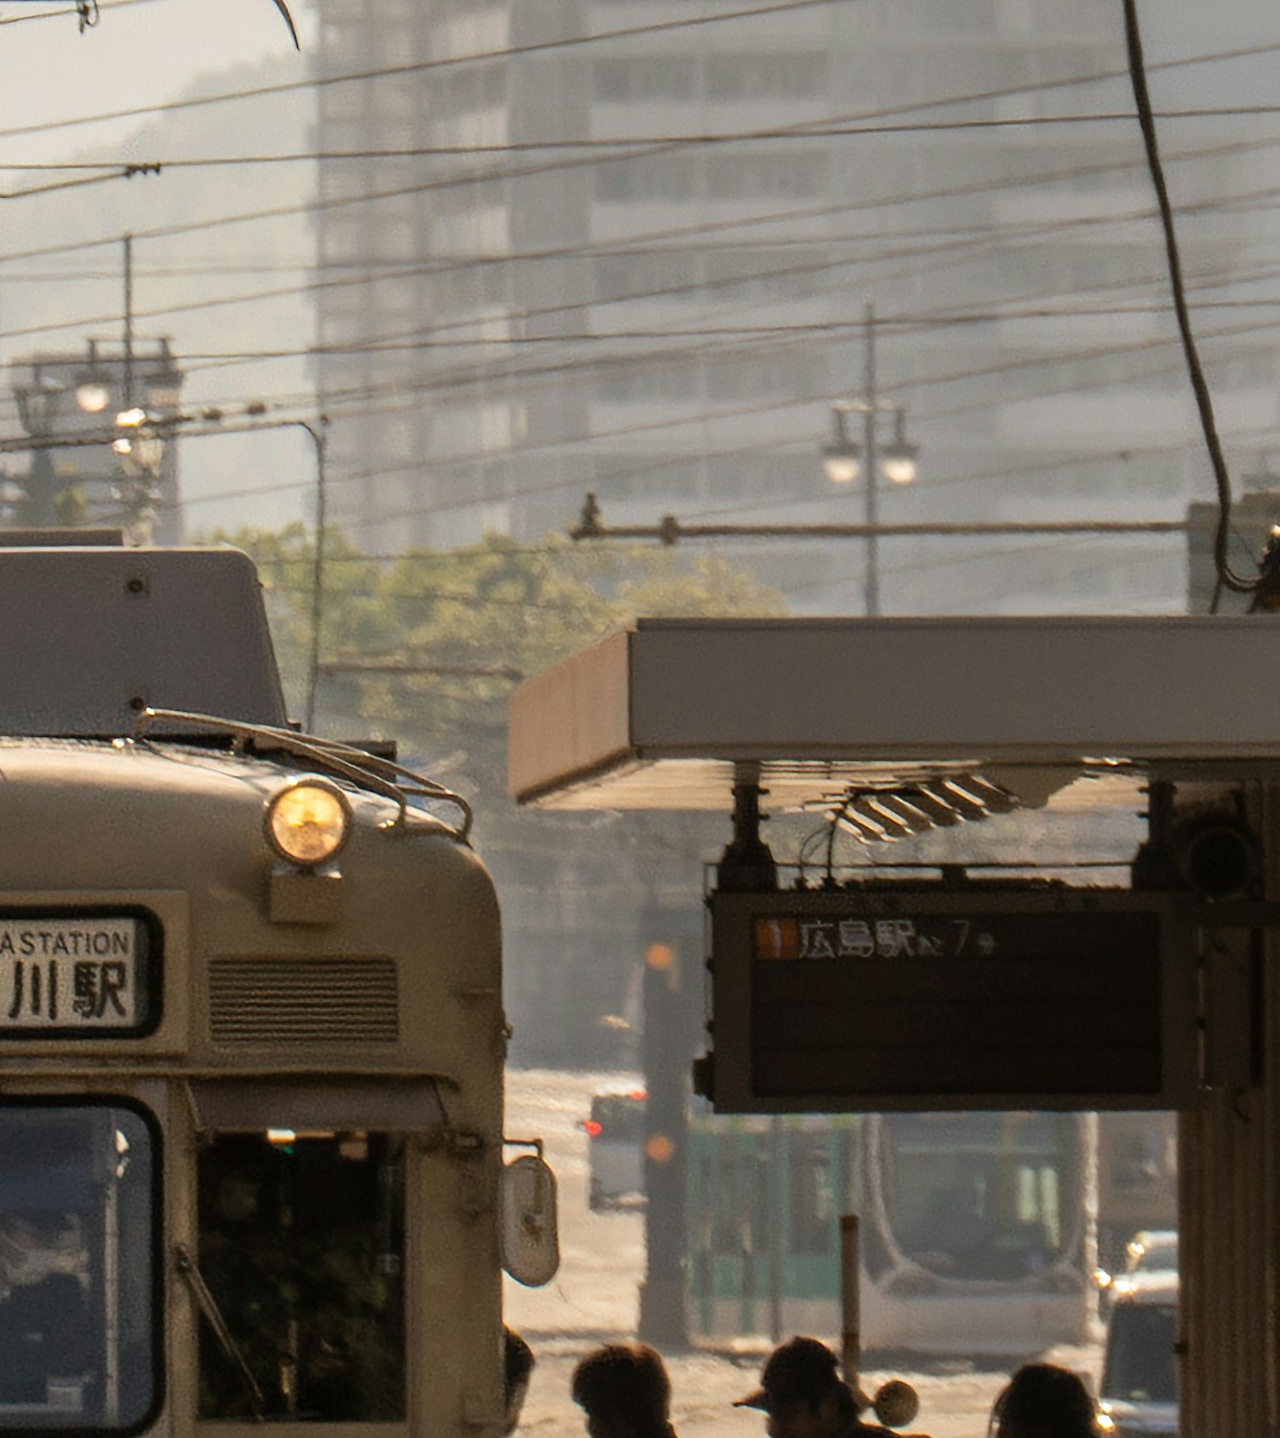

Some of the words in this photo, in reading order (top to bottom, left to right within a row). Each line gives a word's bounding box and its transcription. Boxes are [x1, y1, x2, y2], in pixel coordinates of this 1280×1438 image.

[19, 931, 129, 957] STATION
[799, 919, 917, 958] 広島駅
